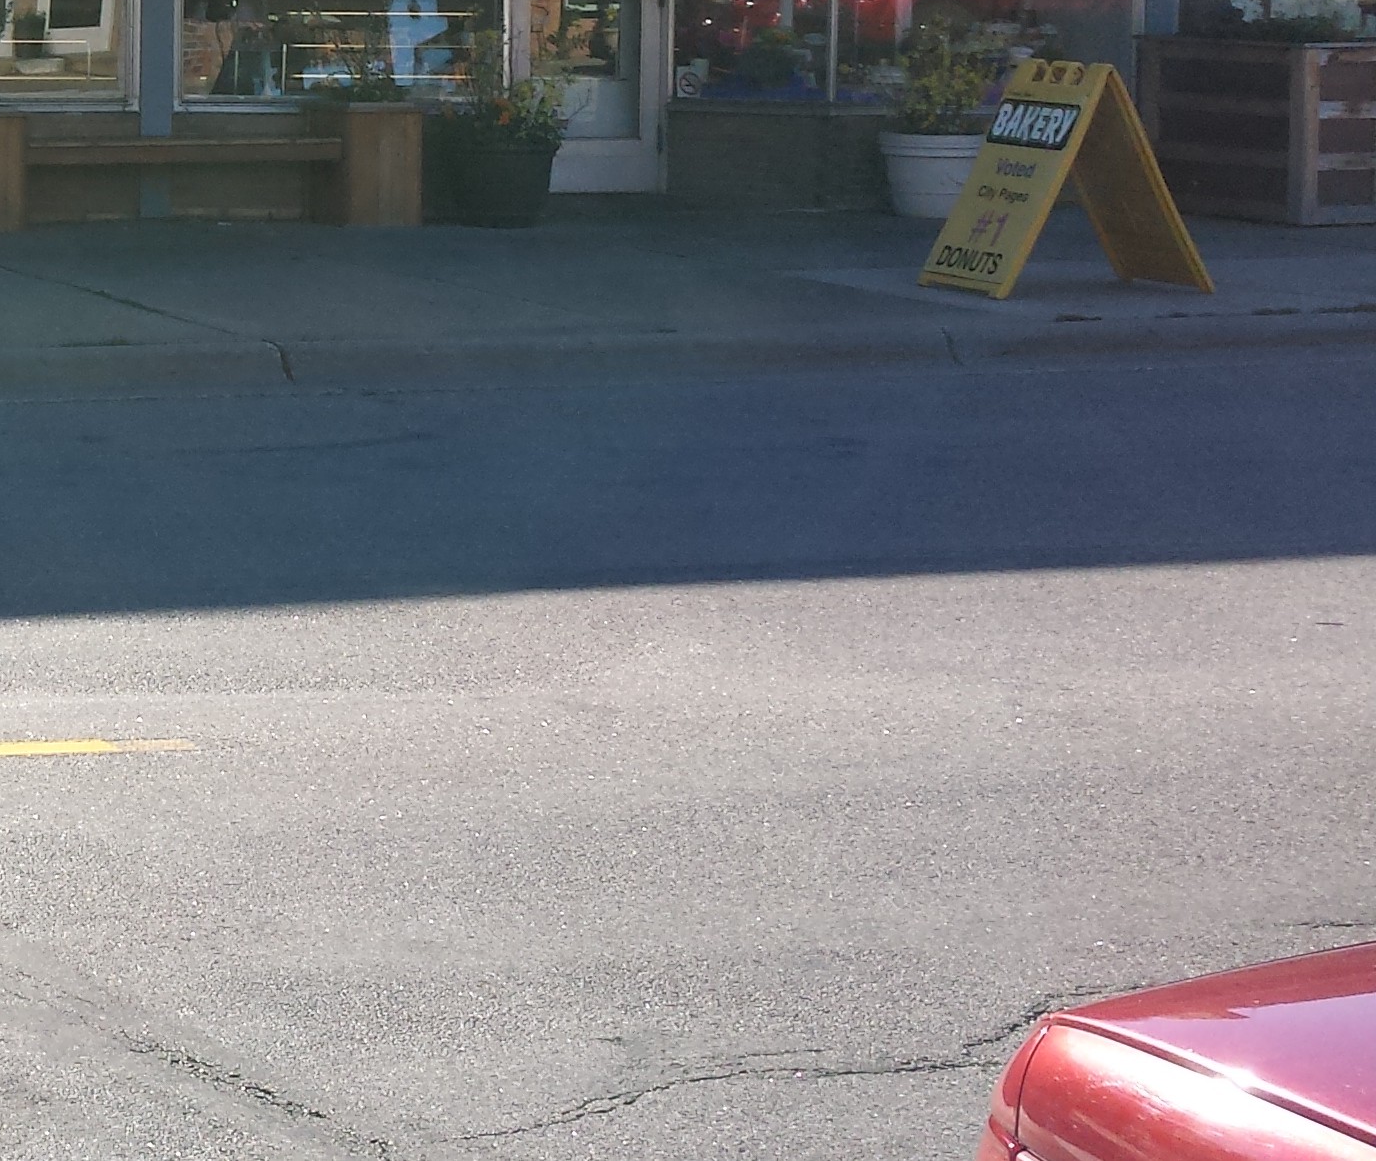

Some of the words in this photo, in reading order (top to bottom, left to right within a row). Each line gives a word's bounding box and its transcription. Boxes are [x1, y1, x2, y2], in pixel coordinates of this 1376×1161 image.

[992, 103, 1077, 143] BAKERY
[996, 158, 1037, 179] Voted
[968, 210, 1009, 247] #1
[935, 244, 1003, 276] DONUTS
